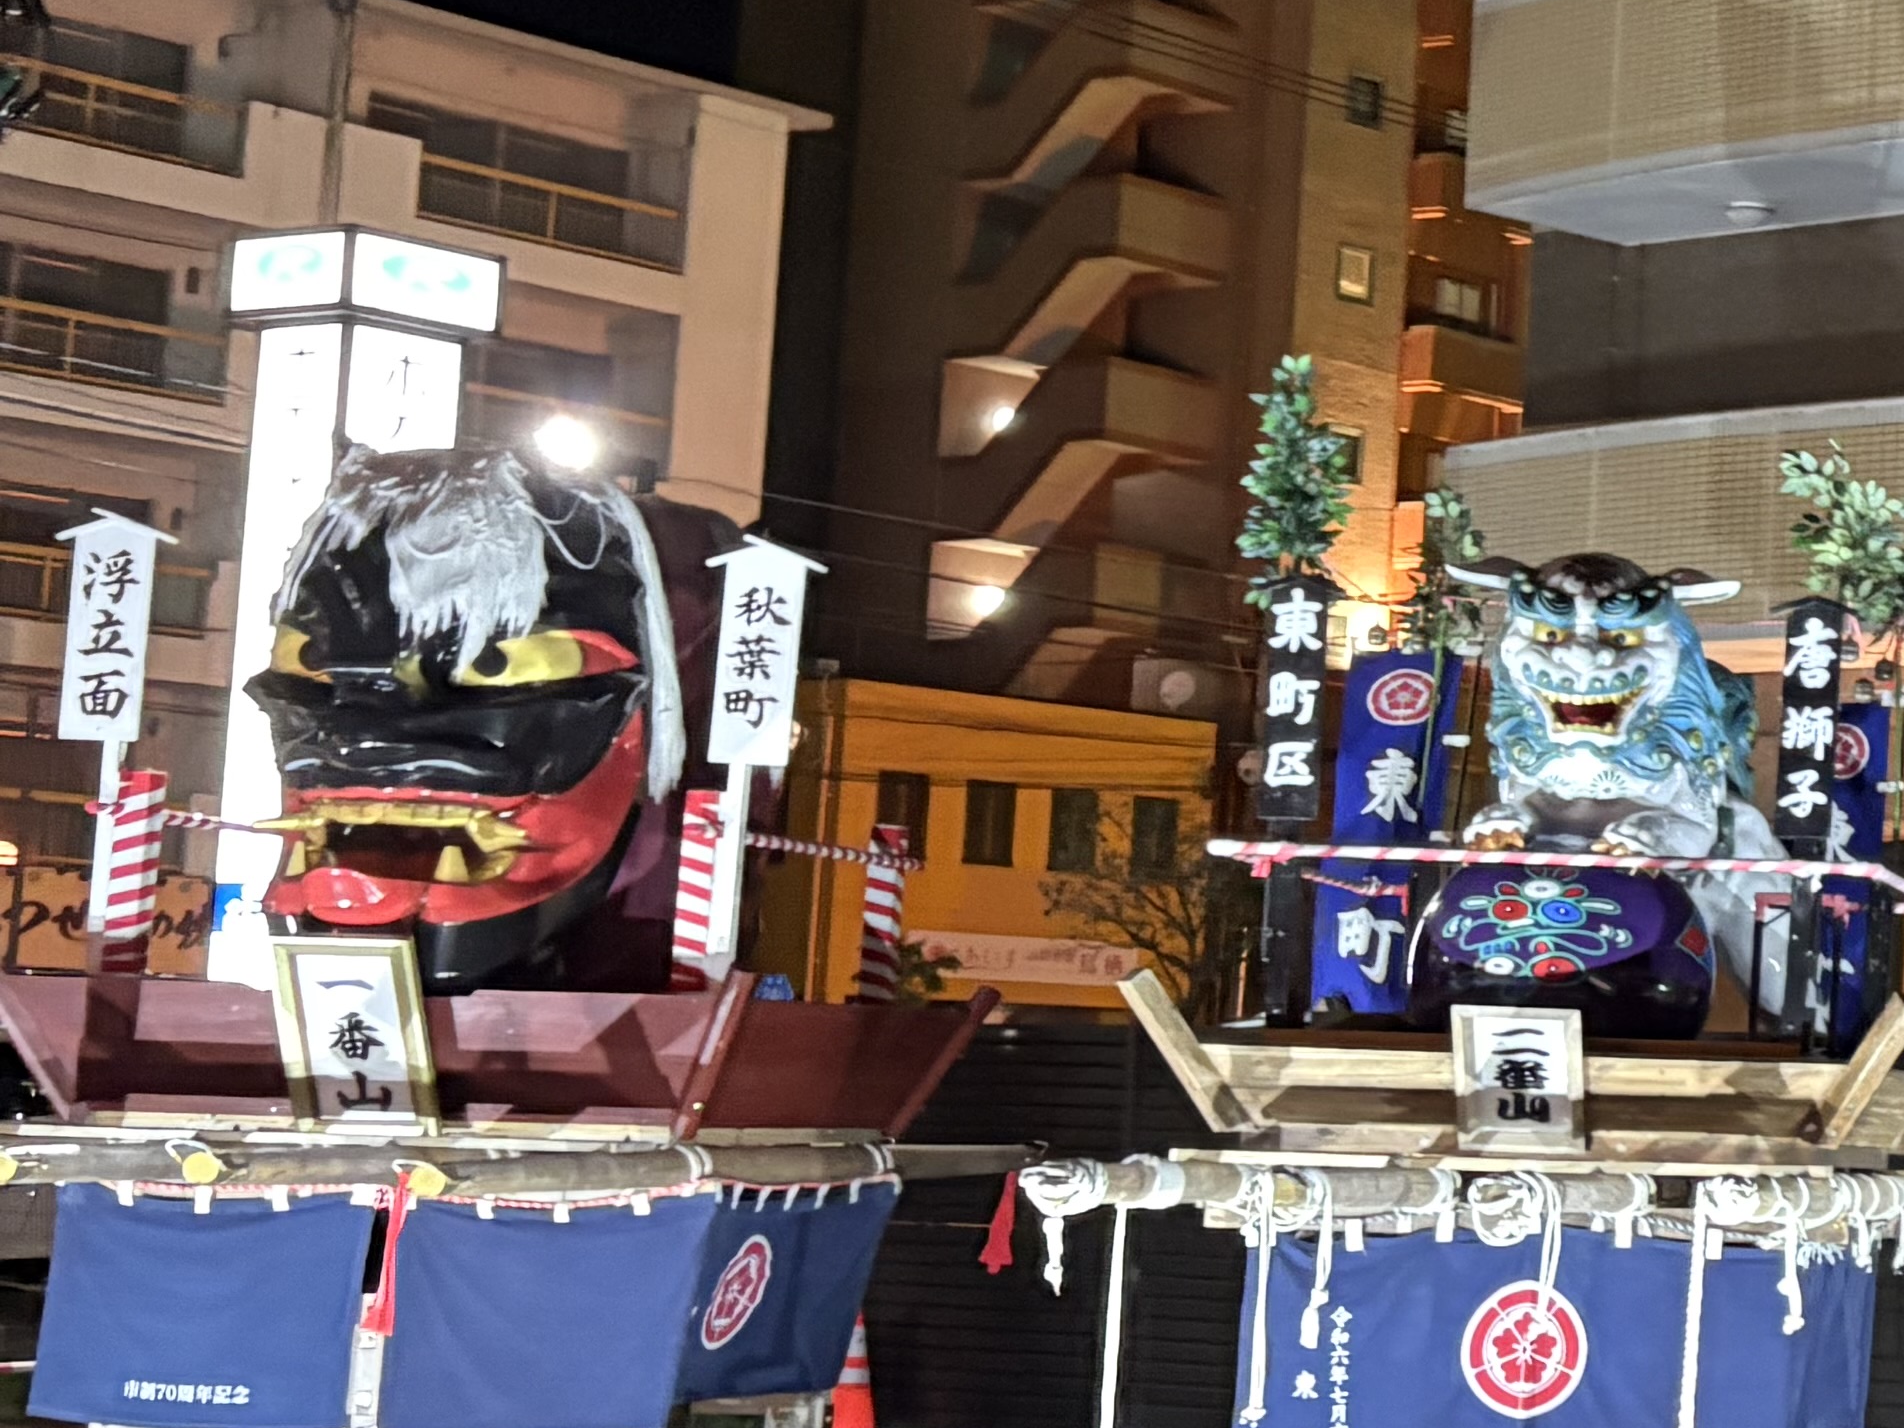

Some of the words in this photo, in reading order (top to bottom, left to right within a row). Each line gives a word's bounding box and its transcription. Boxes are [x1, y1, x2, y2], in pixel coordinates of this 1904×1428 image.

[77, 549, 141, 720] 浮立面
[724, 585, 792, 729] 秋葉町
[1263, 587, 1323, 788] 東町区
[1778, 616, 1839, 820] 唐獅子
[1336, 747, 1419, 984] 東町
[316, 978, 394, 1111] 一番山
[1491, 1028, 1550, 1124] 二番山
[123, 1379, 251, 1405] 市制70周年記念
